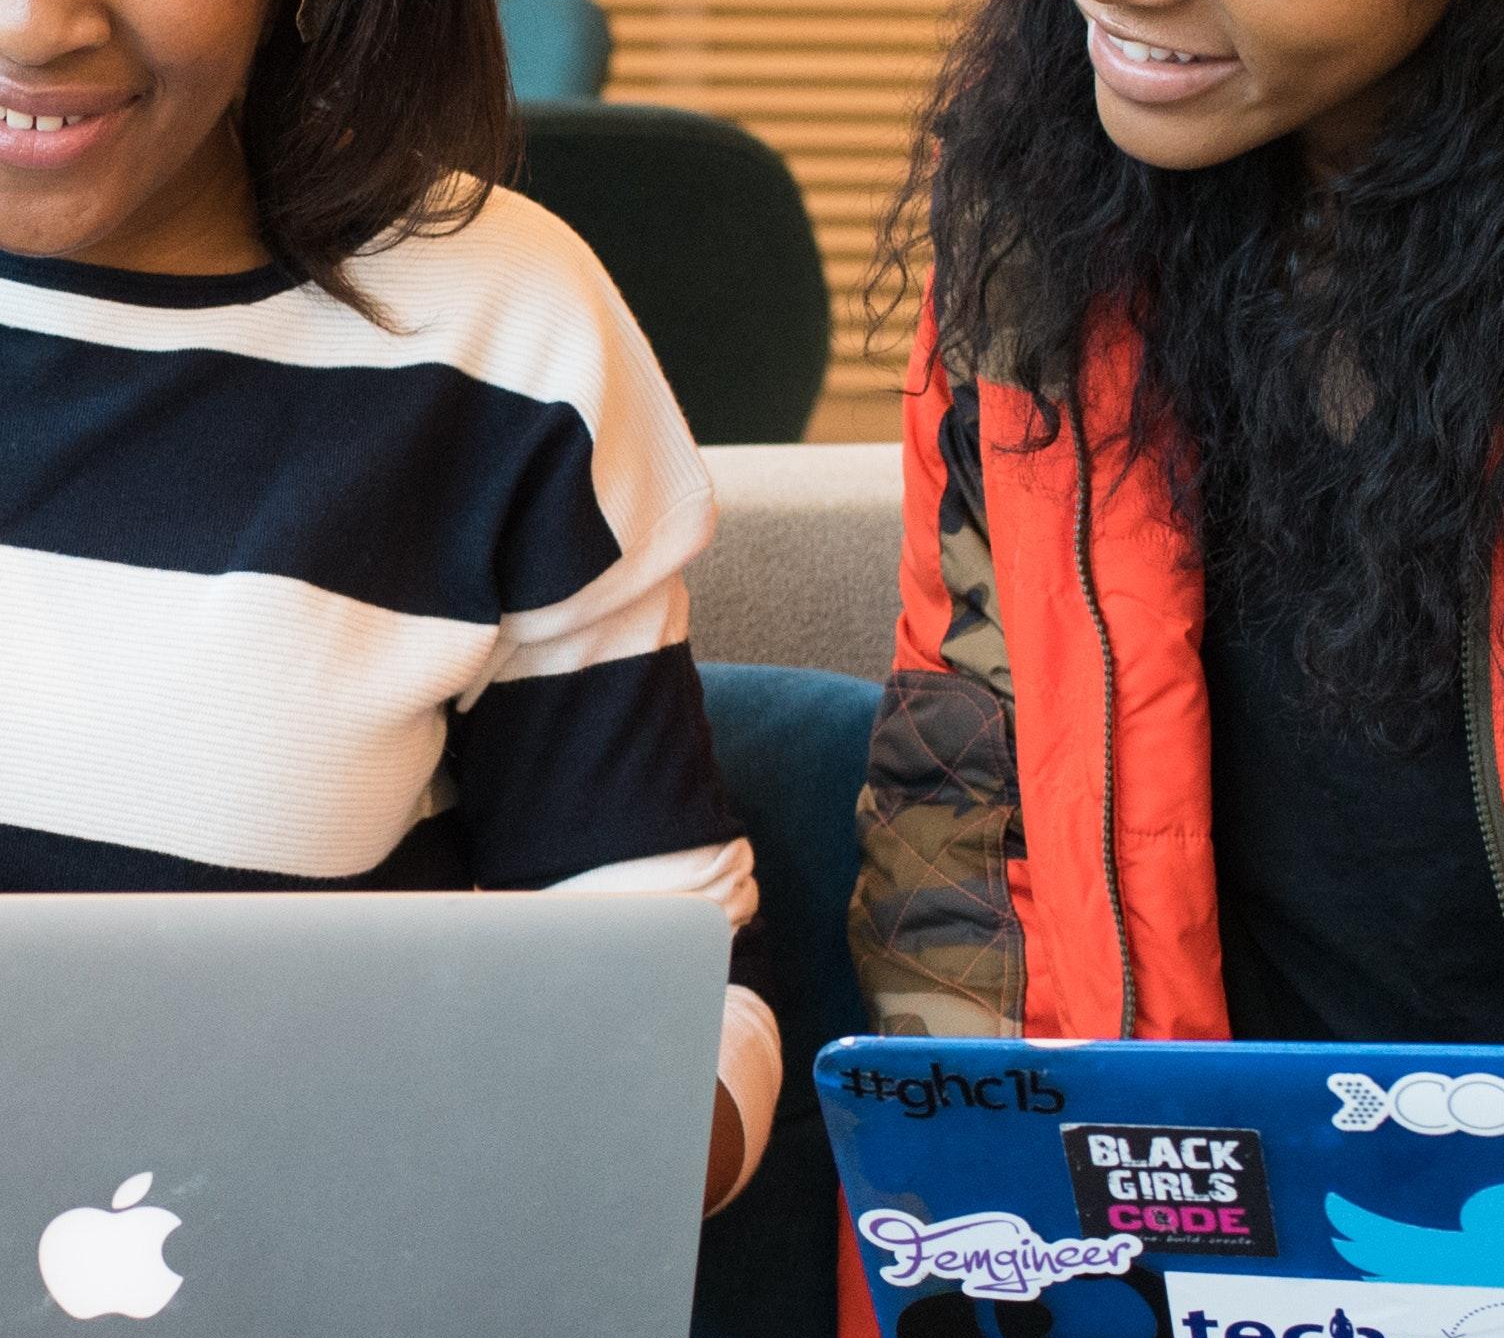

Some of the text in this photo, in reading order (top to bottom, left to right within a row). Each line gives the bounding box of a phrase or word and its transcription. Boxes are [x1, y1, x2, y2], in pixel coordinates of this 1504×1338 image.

[840, 1062, 1066, 1119] #ghc15
[1087, 1134, 1244, 1171] BLACK
[1107, 1169, 1238, 1203] GIRLS
[1107, 1204, 1250, 1235] CODE
[869, 1217, 1131, 1293] Femgineer
